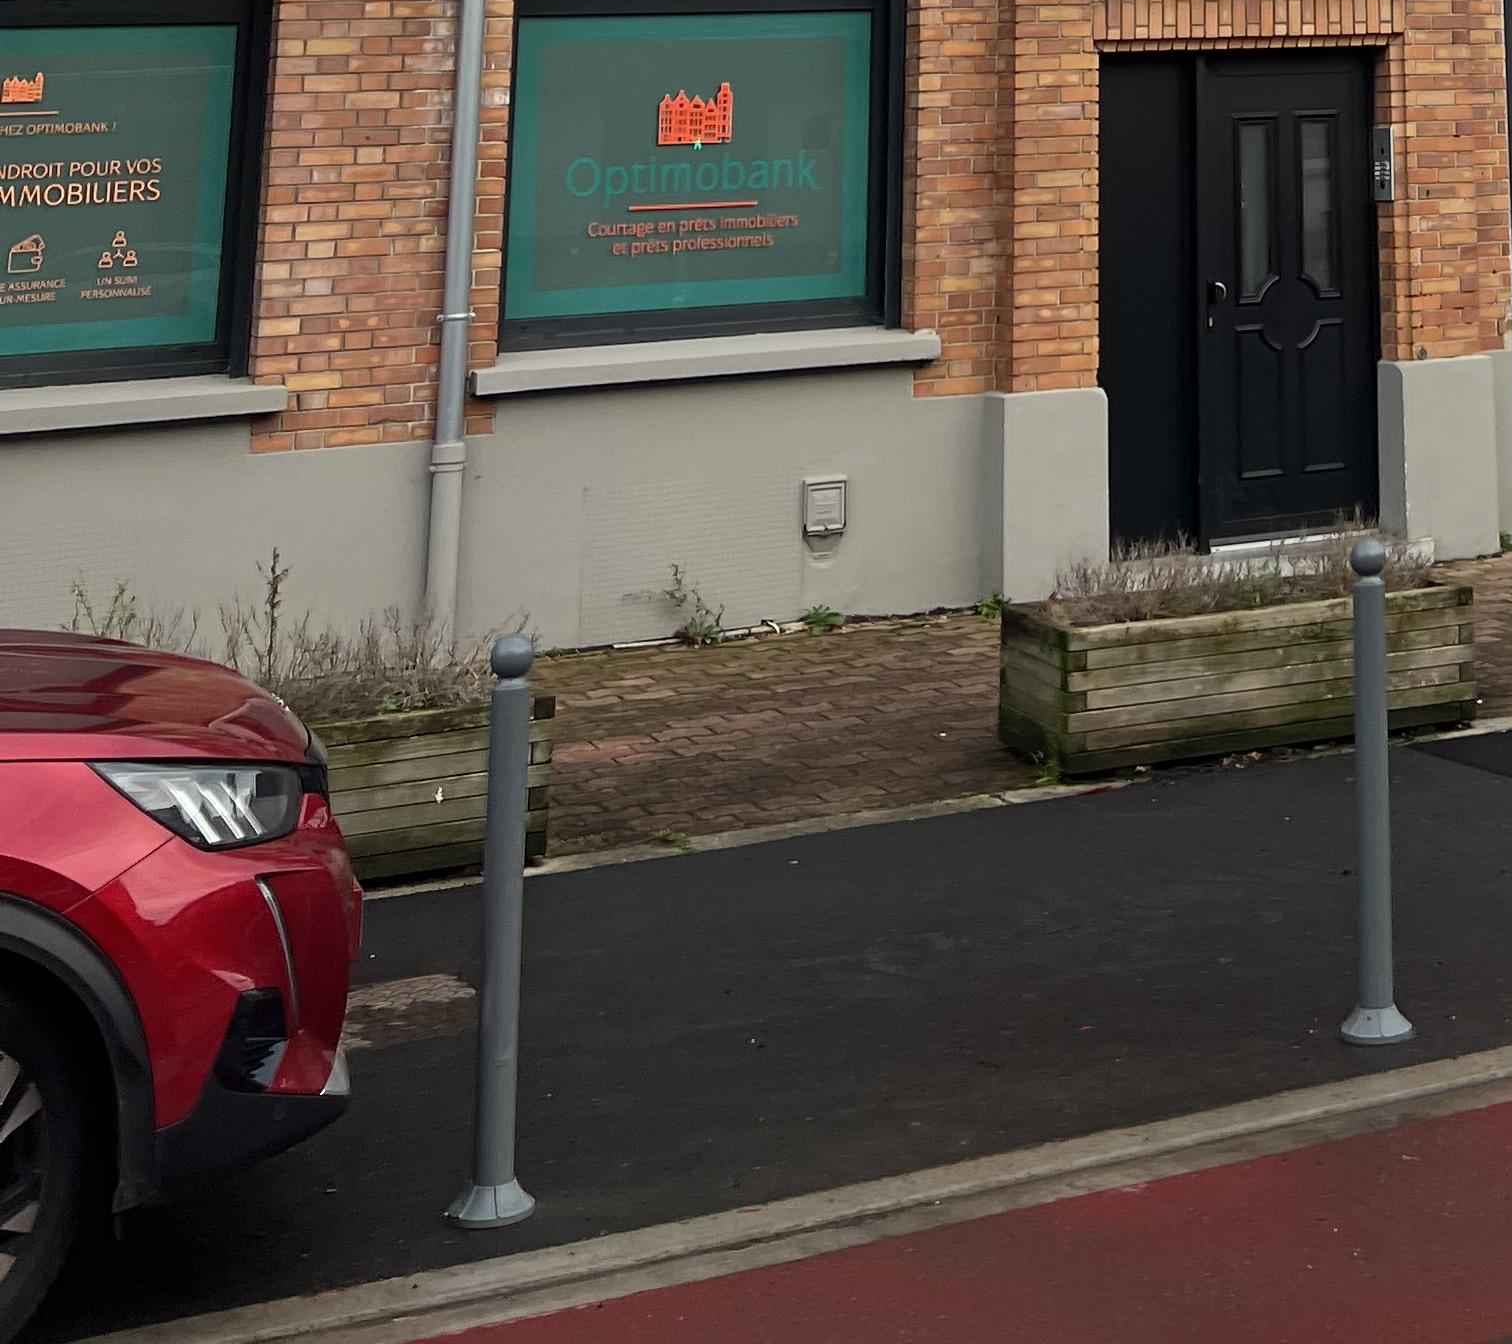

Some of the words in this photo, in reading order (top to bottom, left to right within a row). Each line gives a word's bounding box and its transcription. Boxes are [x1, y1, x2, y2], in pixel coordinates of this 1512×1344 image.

[26, 121, 109, 136] OPTIMOBANK
[70, 159, 122, 177] POUR
[127, 158, 162, 175] VOS
[565, 148, 820, 209] Optimobank
[587, 221, 654, 238] Courtage
[658, 221, 676, 234] en
[678, 216, 716, 237] prêts
[612, 242, 628, 256] et
[630, 236, 669, 257] prêts
[672, 231, 776, 255] professionnels
[8, 278, 66, 291] ASSURANCE
